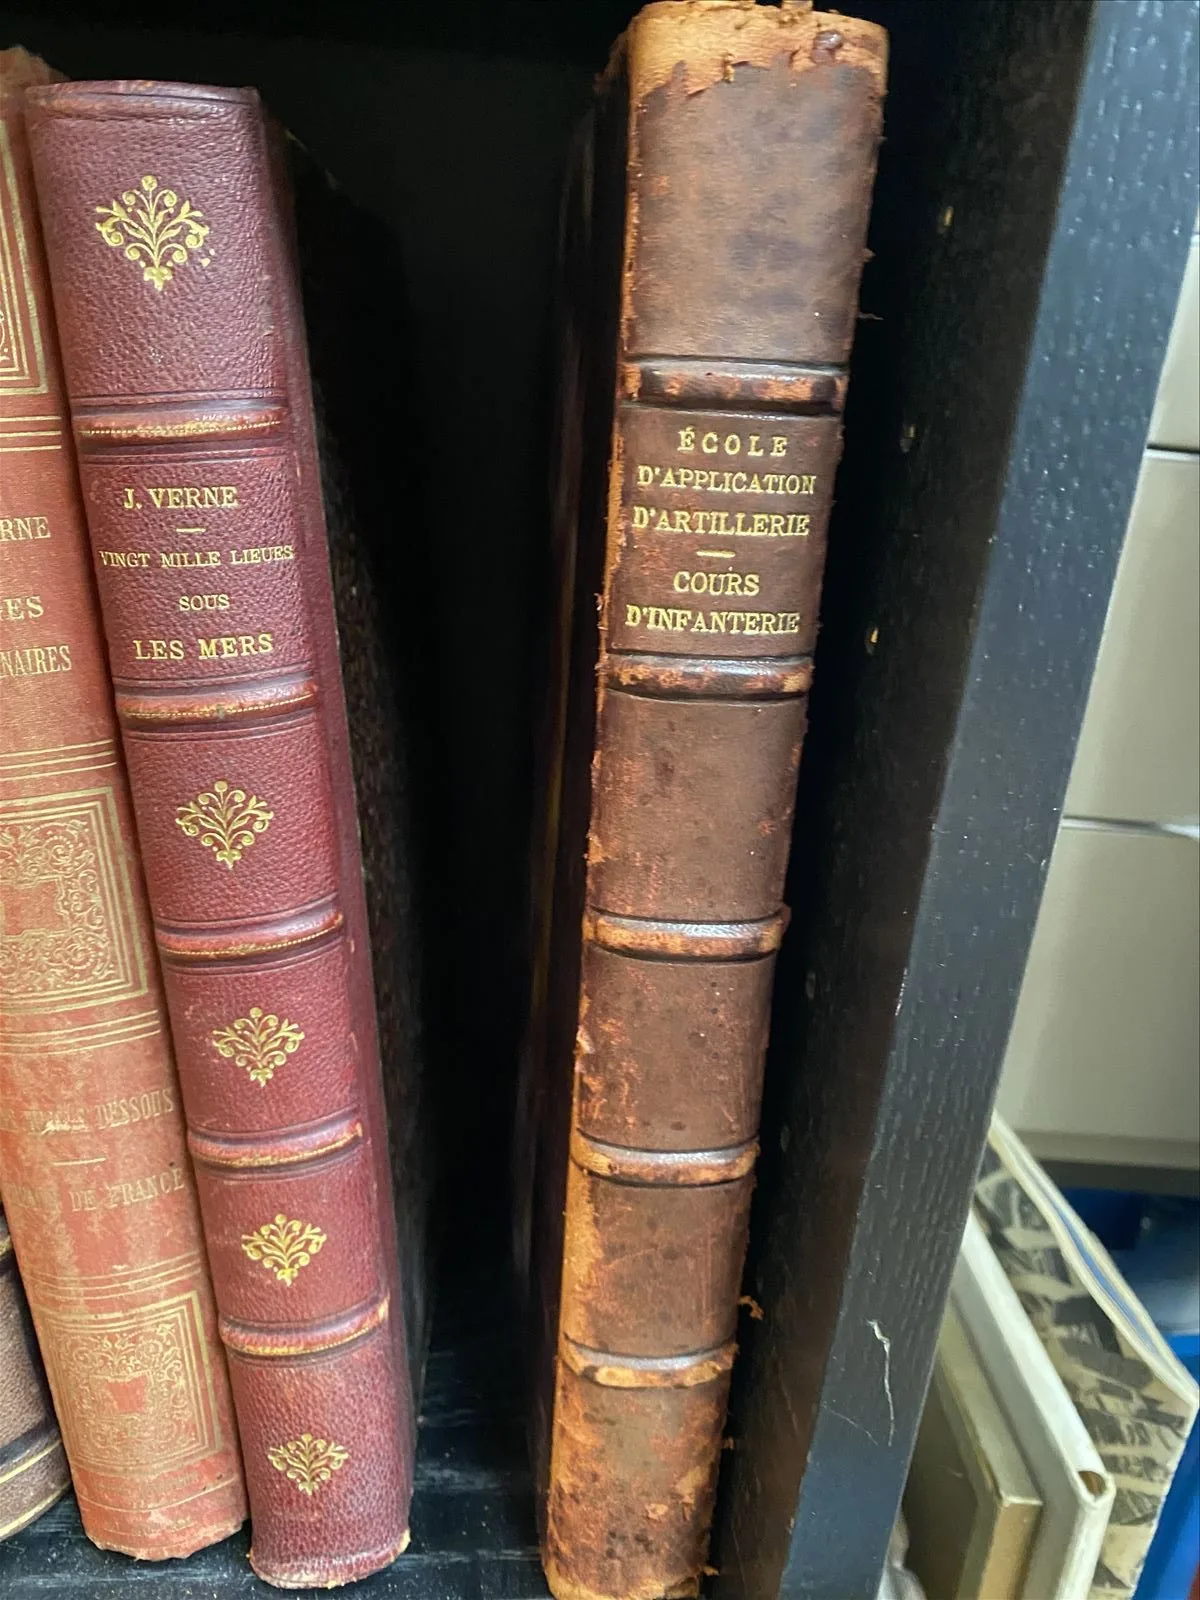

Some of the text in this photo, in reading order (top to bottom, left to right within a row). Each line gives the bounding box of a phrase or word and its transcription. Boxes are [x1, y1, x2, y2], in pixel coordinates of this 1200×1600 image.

[677, 426, 788, 457] ÉCOLE
[637, 465, 816, 495] D'APPLICATION
[124, 486, 238, 510] J. VERNE
[632, 506, 811, 537] D'ARTILLERIE
[100, 545, 294, 568] VINGT MILLE LIEUES
[673, 570, 760, 596] COURS
[179, 594, 230, 611] SOUS
[625, 604, 801, 635] D'INFANTERIE
[133, 633, 273, 660] LES MERS
